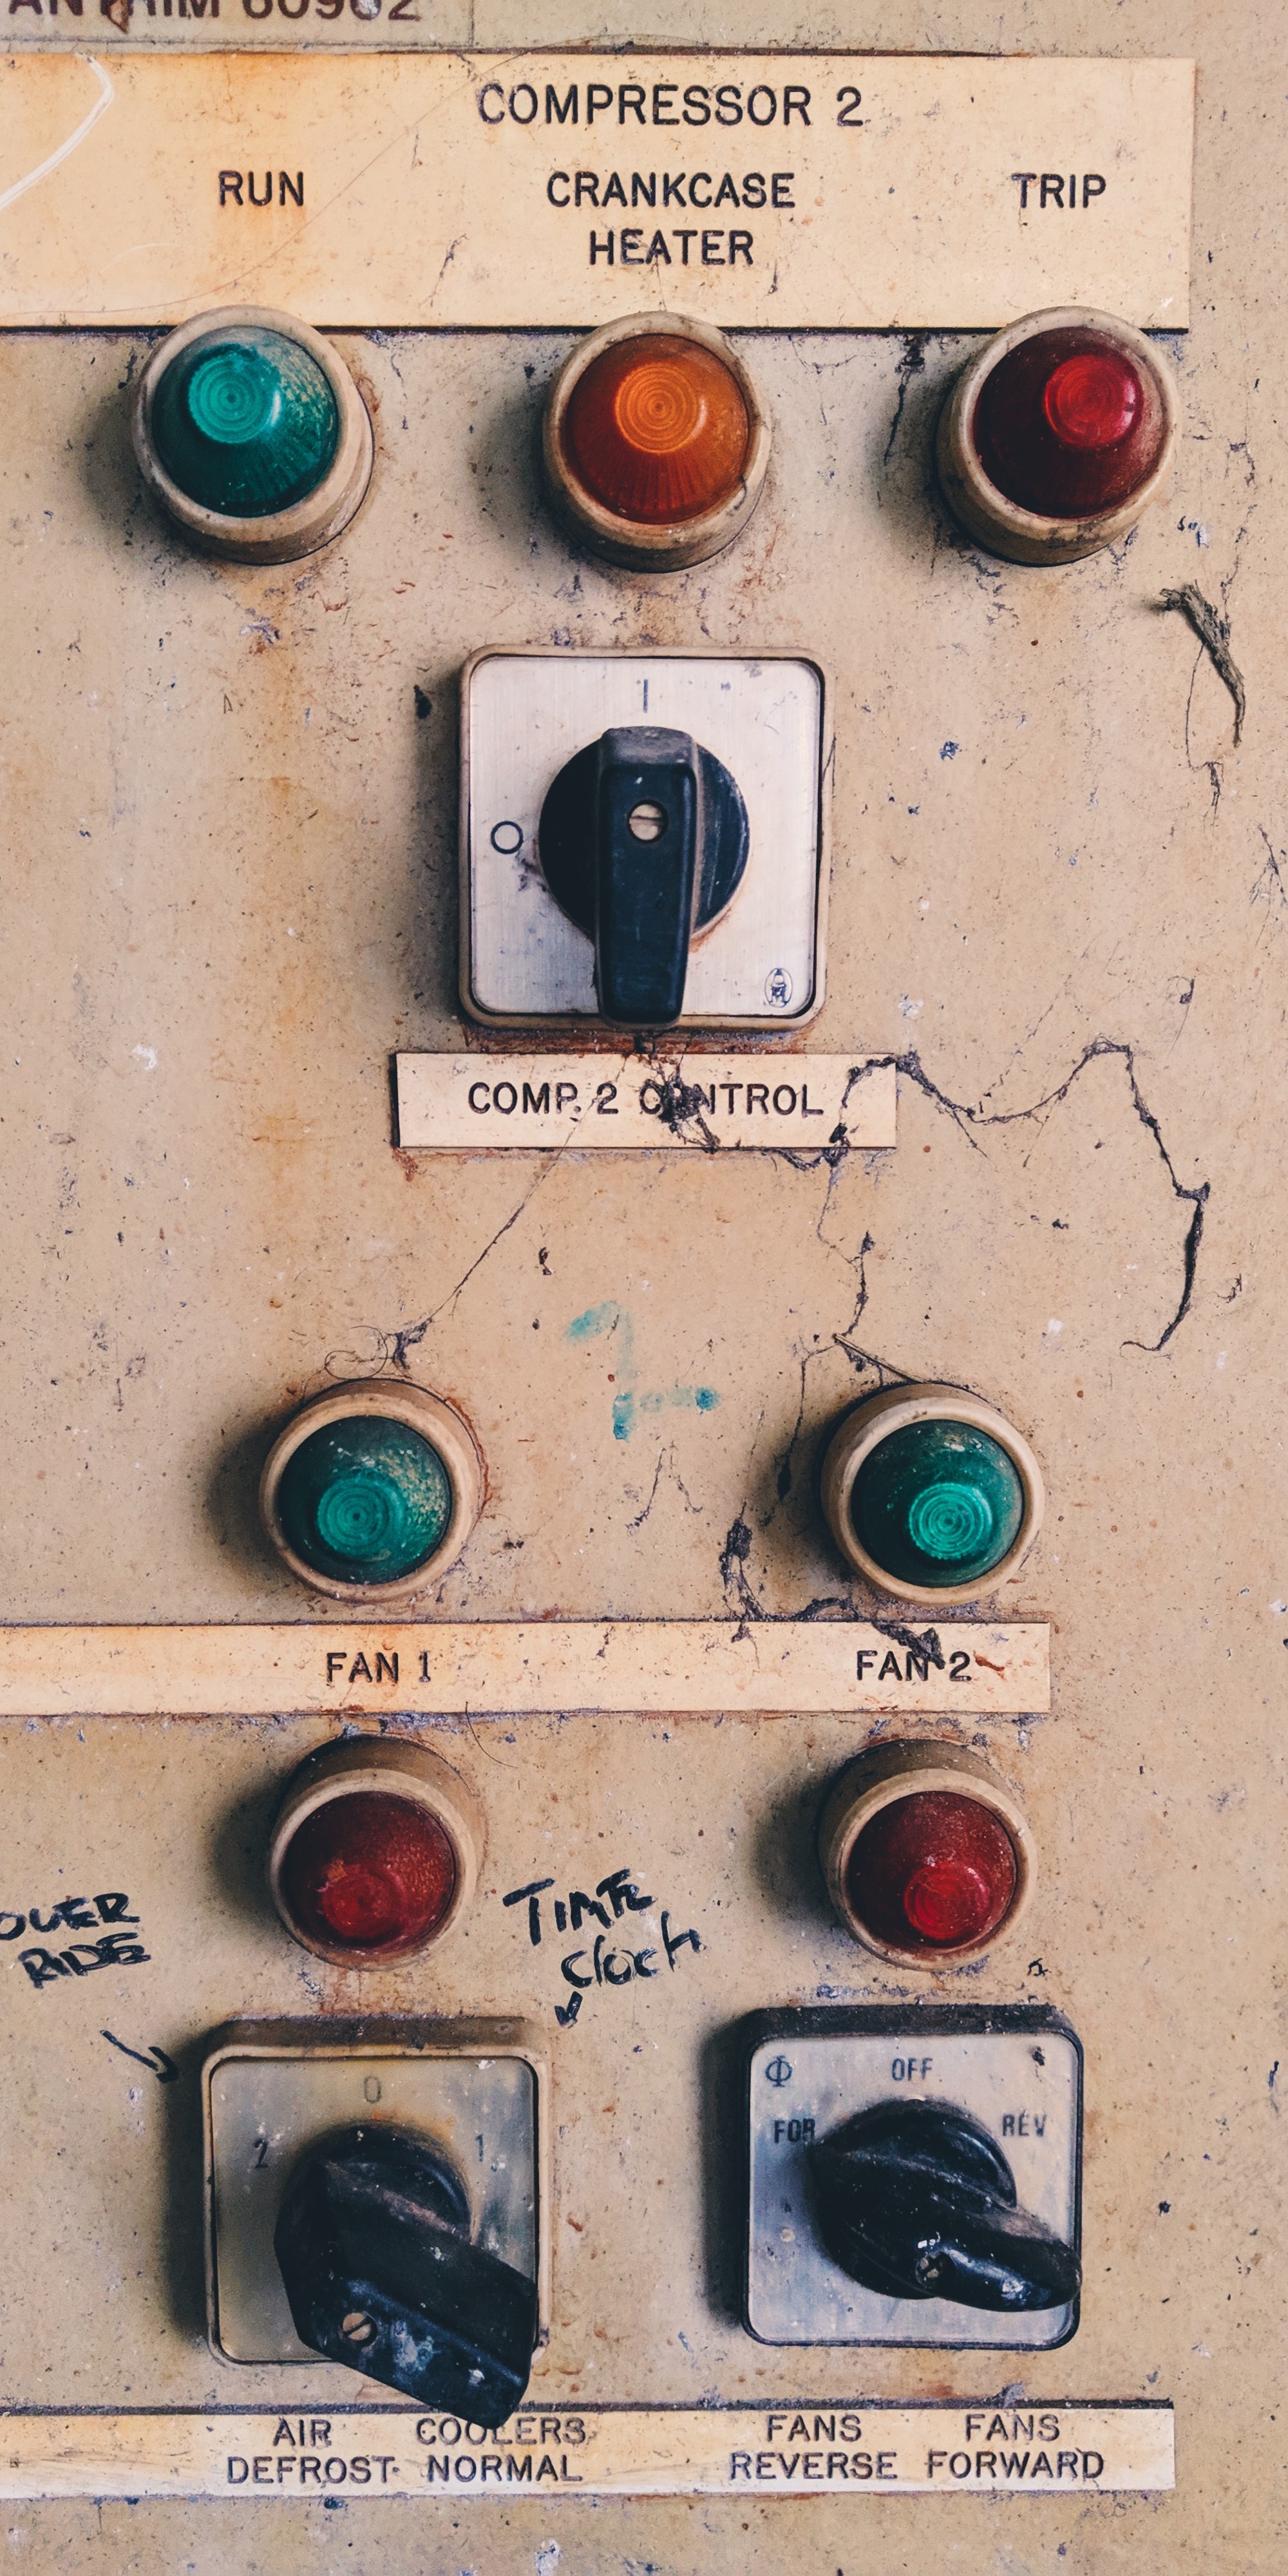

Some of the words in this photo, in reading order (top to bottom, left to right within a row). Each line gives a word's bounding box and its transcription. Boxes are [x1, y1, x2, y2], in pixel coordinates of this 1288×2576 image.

[478, 83, 811, 126] COMPRESSOR
[835, 86, 864, 126] 2
[218, 170, 305, 206] RUN
[546, 171, 796, 209] CRANKCASE
[1011, 173, 1107, 209] TRIP
[588, 229, 754, 266] HEATER
[468, 1083, 582, 1114] COMP.
[596, 1083, 618, 1114] 2
[639, 1079, 824, 1115] CNTROL
[327, 1652, 399, 1683] FAN
[857, 1650, 929, 1681] FAN
[949, 1651, 972, 1681] 2
[891, 2058, 933, 2081] OFF
[774, 2118, 815, 2143] FOR
[272, 2418, 332, 2447] AIR
[417, 2417, 586, 2445] COOLERS
[767, 2414, 862, 2442] FANS
[966, 2414, 1060, 2442] FANS
[227, 2456, 395, 2485] DEFROST
[428, 2454, 583, 2482] NORMAL
[730, 2451, 897, 2479] REVERSE
[927, 2449, 1104, 2479] FORWARD
